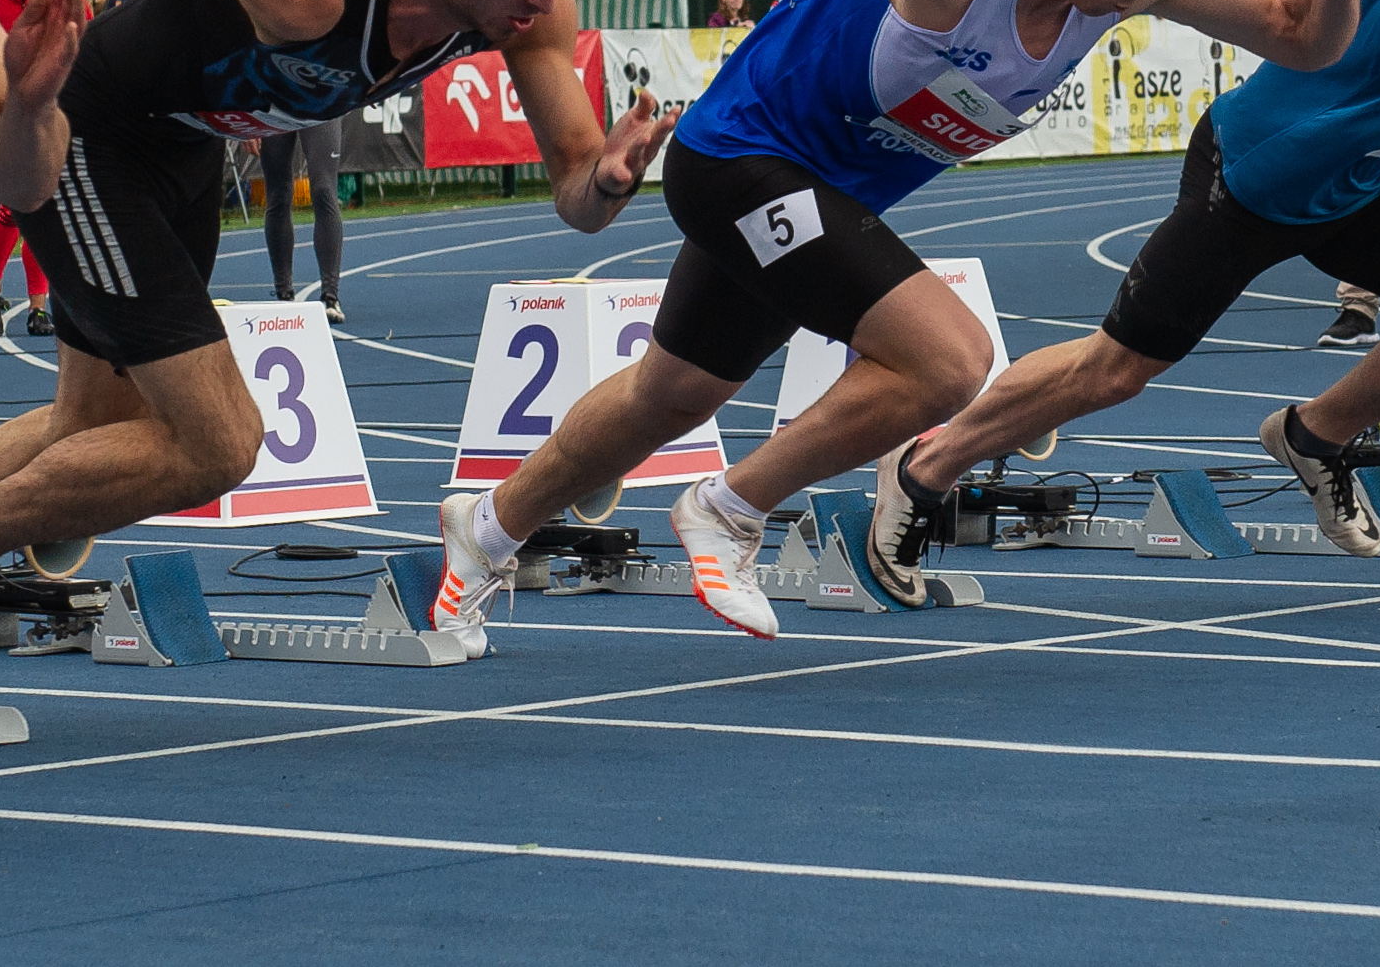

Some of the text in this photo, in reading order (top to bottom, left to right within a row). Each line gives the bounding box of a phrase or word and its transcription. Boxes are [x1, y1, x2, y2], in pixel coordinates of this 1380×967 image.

[922, 112, 997, 150] SIUD
[766, 202, 795, 247] 5
[520, 296, 566, 313] polanik
[619, 291, 662, 312] polanik
[258, 315, 305, 336] polanik
[497, 324, 559, 436] 2
[254, 346, 317, 464] 3
